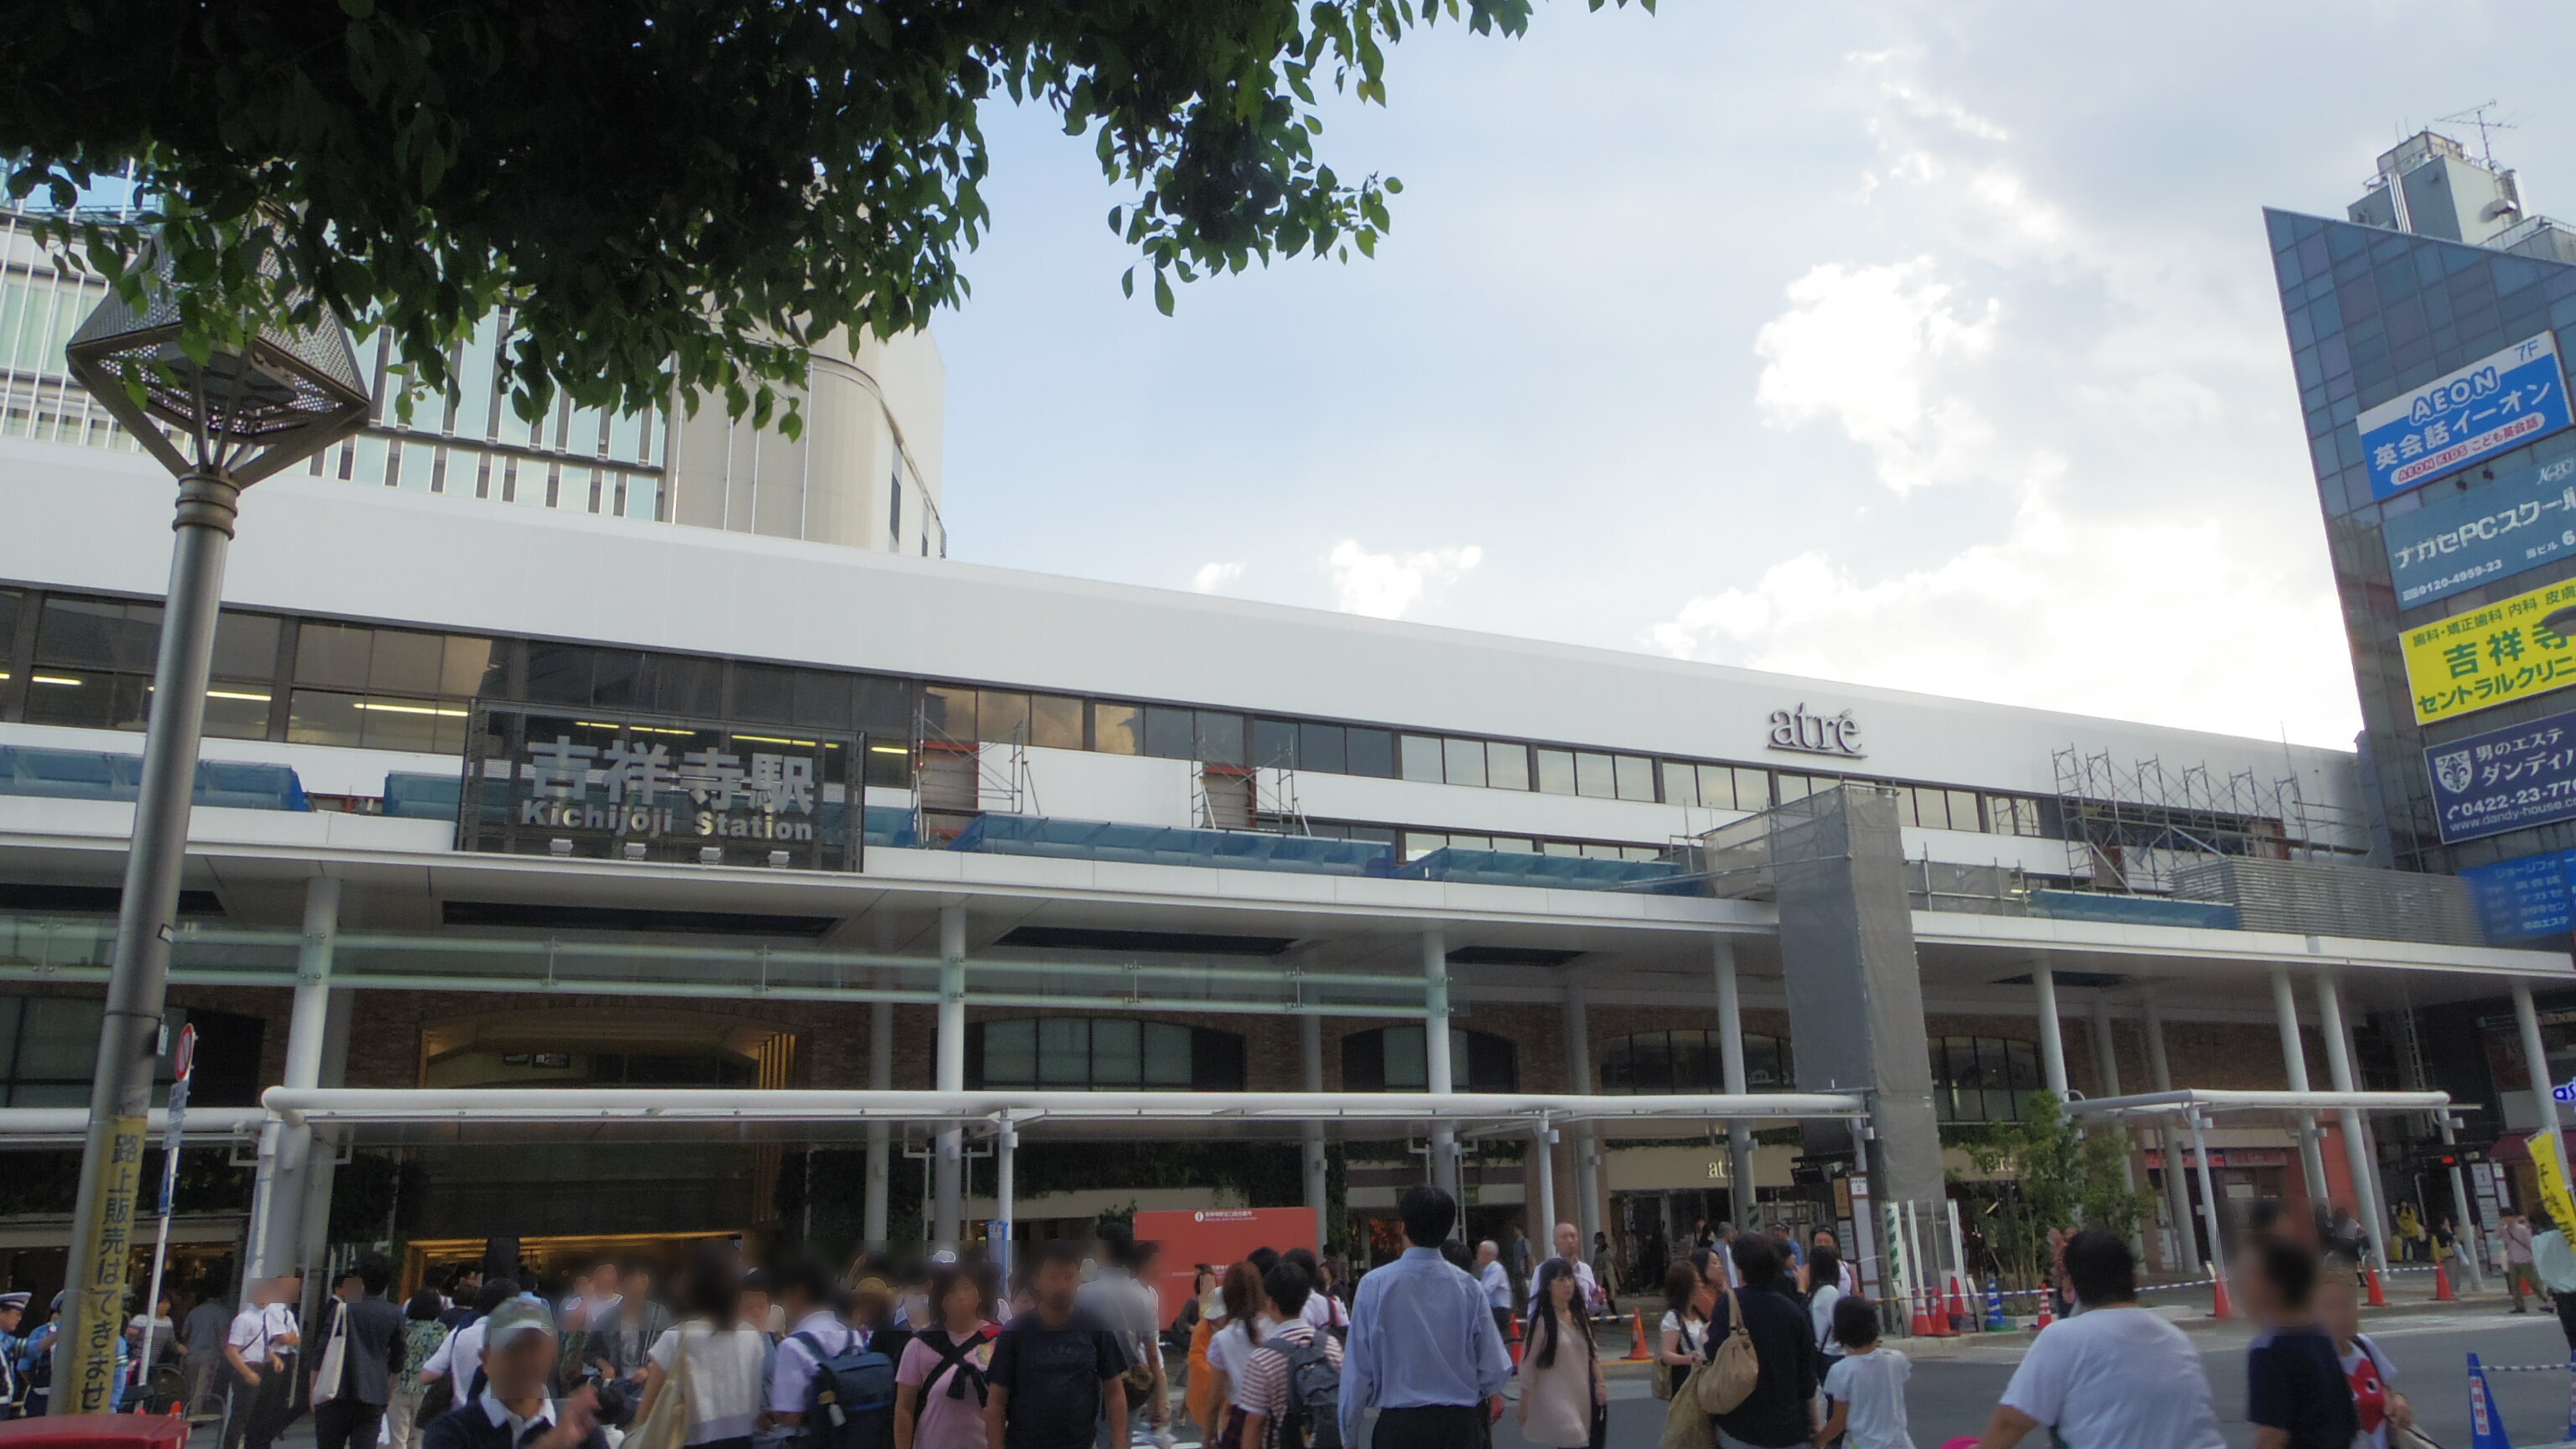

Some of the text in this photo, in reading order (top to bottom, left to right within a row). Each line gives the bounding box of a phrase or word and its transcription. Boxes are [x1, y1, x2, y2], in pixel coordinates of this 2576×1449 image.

[2514, 340, 2538, 361] 7F
[2410, 366, 2500, 425] AEON
[2373, 382, 2550, 470] 英会話イーオン
[2398, 457, 2436, 482] AEON
[2437, 444, 2468, 465] KIDS
[2508, 597, 2537, 617] 内科
[2444, 622, 2568, 679] 吉祥寺
[1769, 702, 1862, 754] atré
[2476, 728, 2563, 762] 男のエステ
[527, 735, 814, 815] 吉祥寺駅
[694, 810, 813, 839] Station
